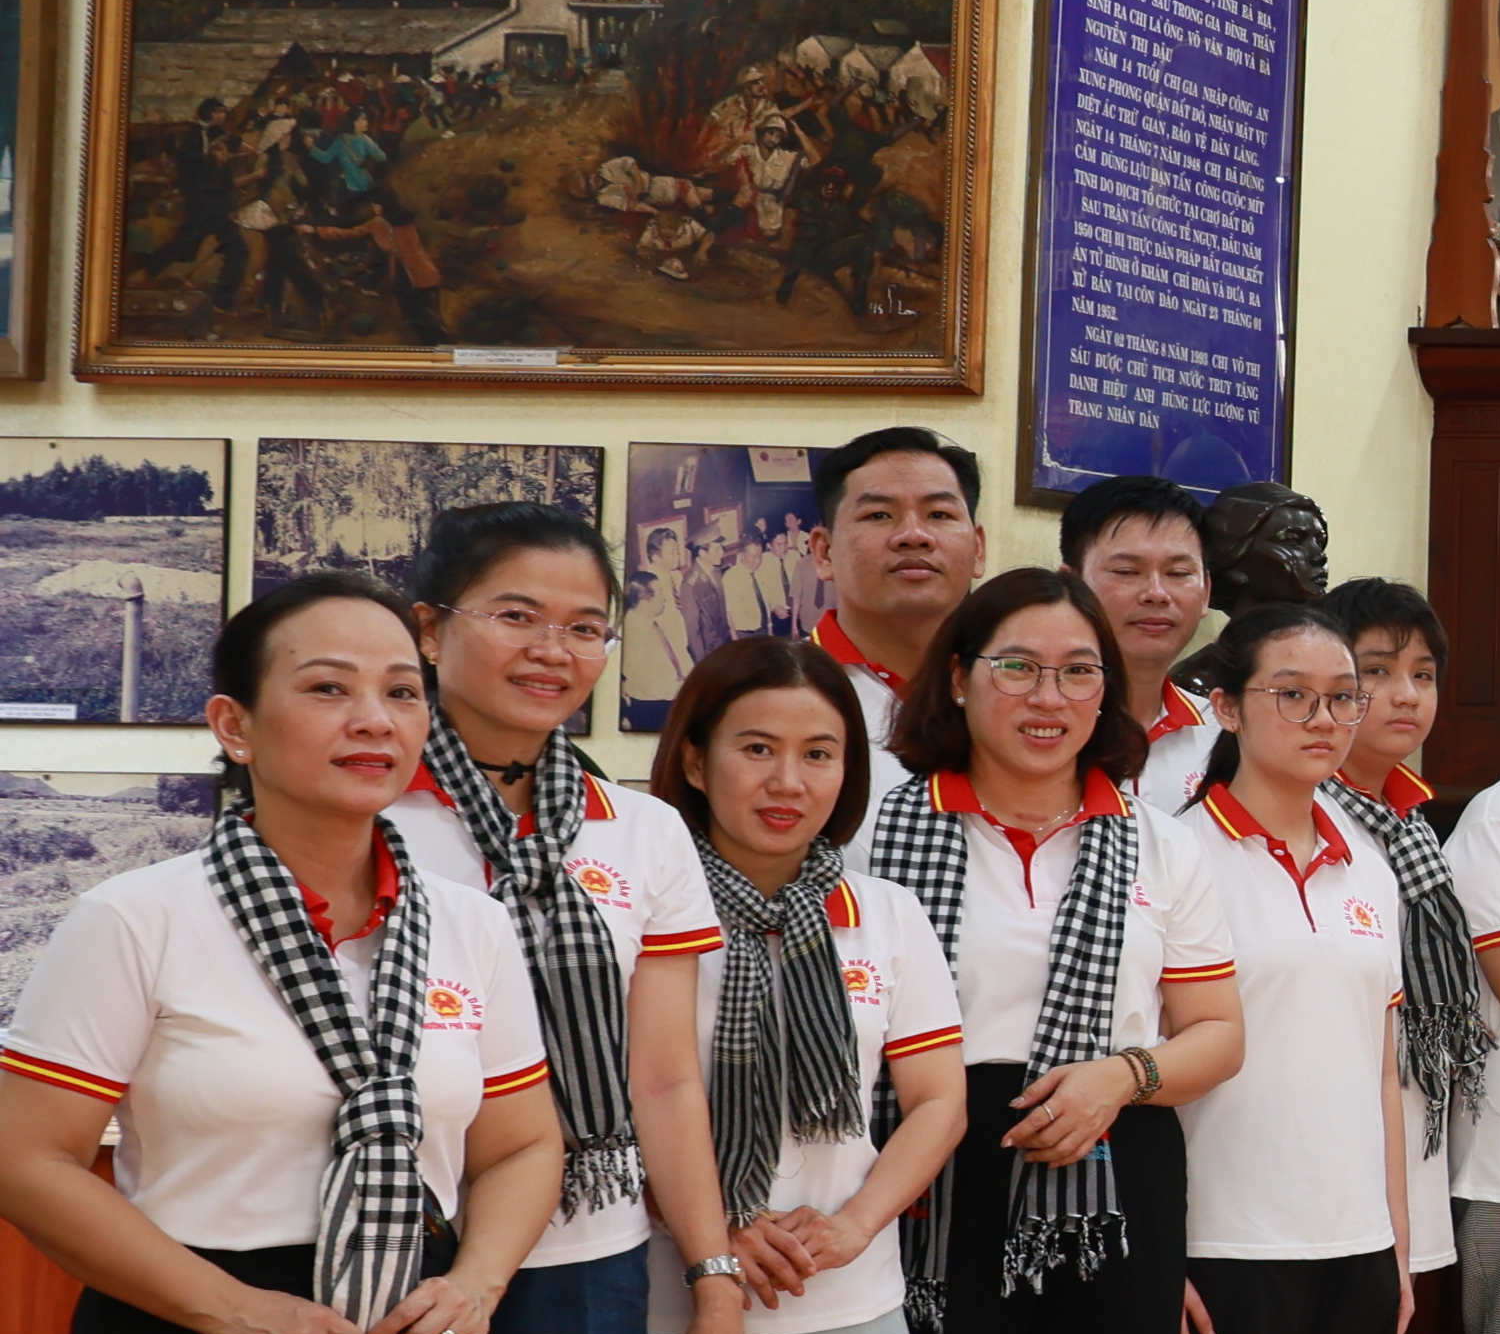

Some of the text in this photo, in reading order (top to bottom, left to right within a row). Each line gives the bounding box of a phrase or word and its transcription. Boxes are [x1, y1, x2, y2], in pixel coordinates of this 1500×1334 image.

[1241, 3, 1254, 22] BÀ
[1131, 34, 1149, 57] THỊ
[1094, 46, 1270, 123] NĂM 14 TUỔI CHỊ GIA NHẬP CÔNG AN
[1071, 295, 1095, 316] NĂM
[1069, 345, 1091, 366] SÁU
[1095, 352, 1123, 373] ĐƯỢC
[1127, 357, 1148, 378] CHỦ
[1152, 365, 1175, 384] TỊCH
[1178, 370, 1205, 389] NƯỚC
[1208, 377, 1233, 395] TRUY
[1068, 398, 1160, 429] TRANG NHÂN DÂN
[1069, 373, 1099, 393] DANH
[1102, 378, 1128, 399] HIỆU
[1133, 387, 1155, 404] ANH
[1192, 397, 1211, 417] LỰC
[1247, 407, 1261, 425] VŨ
